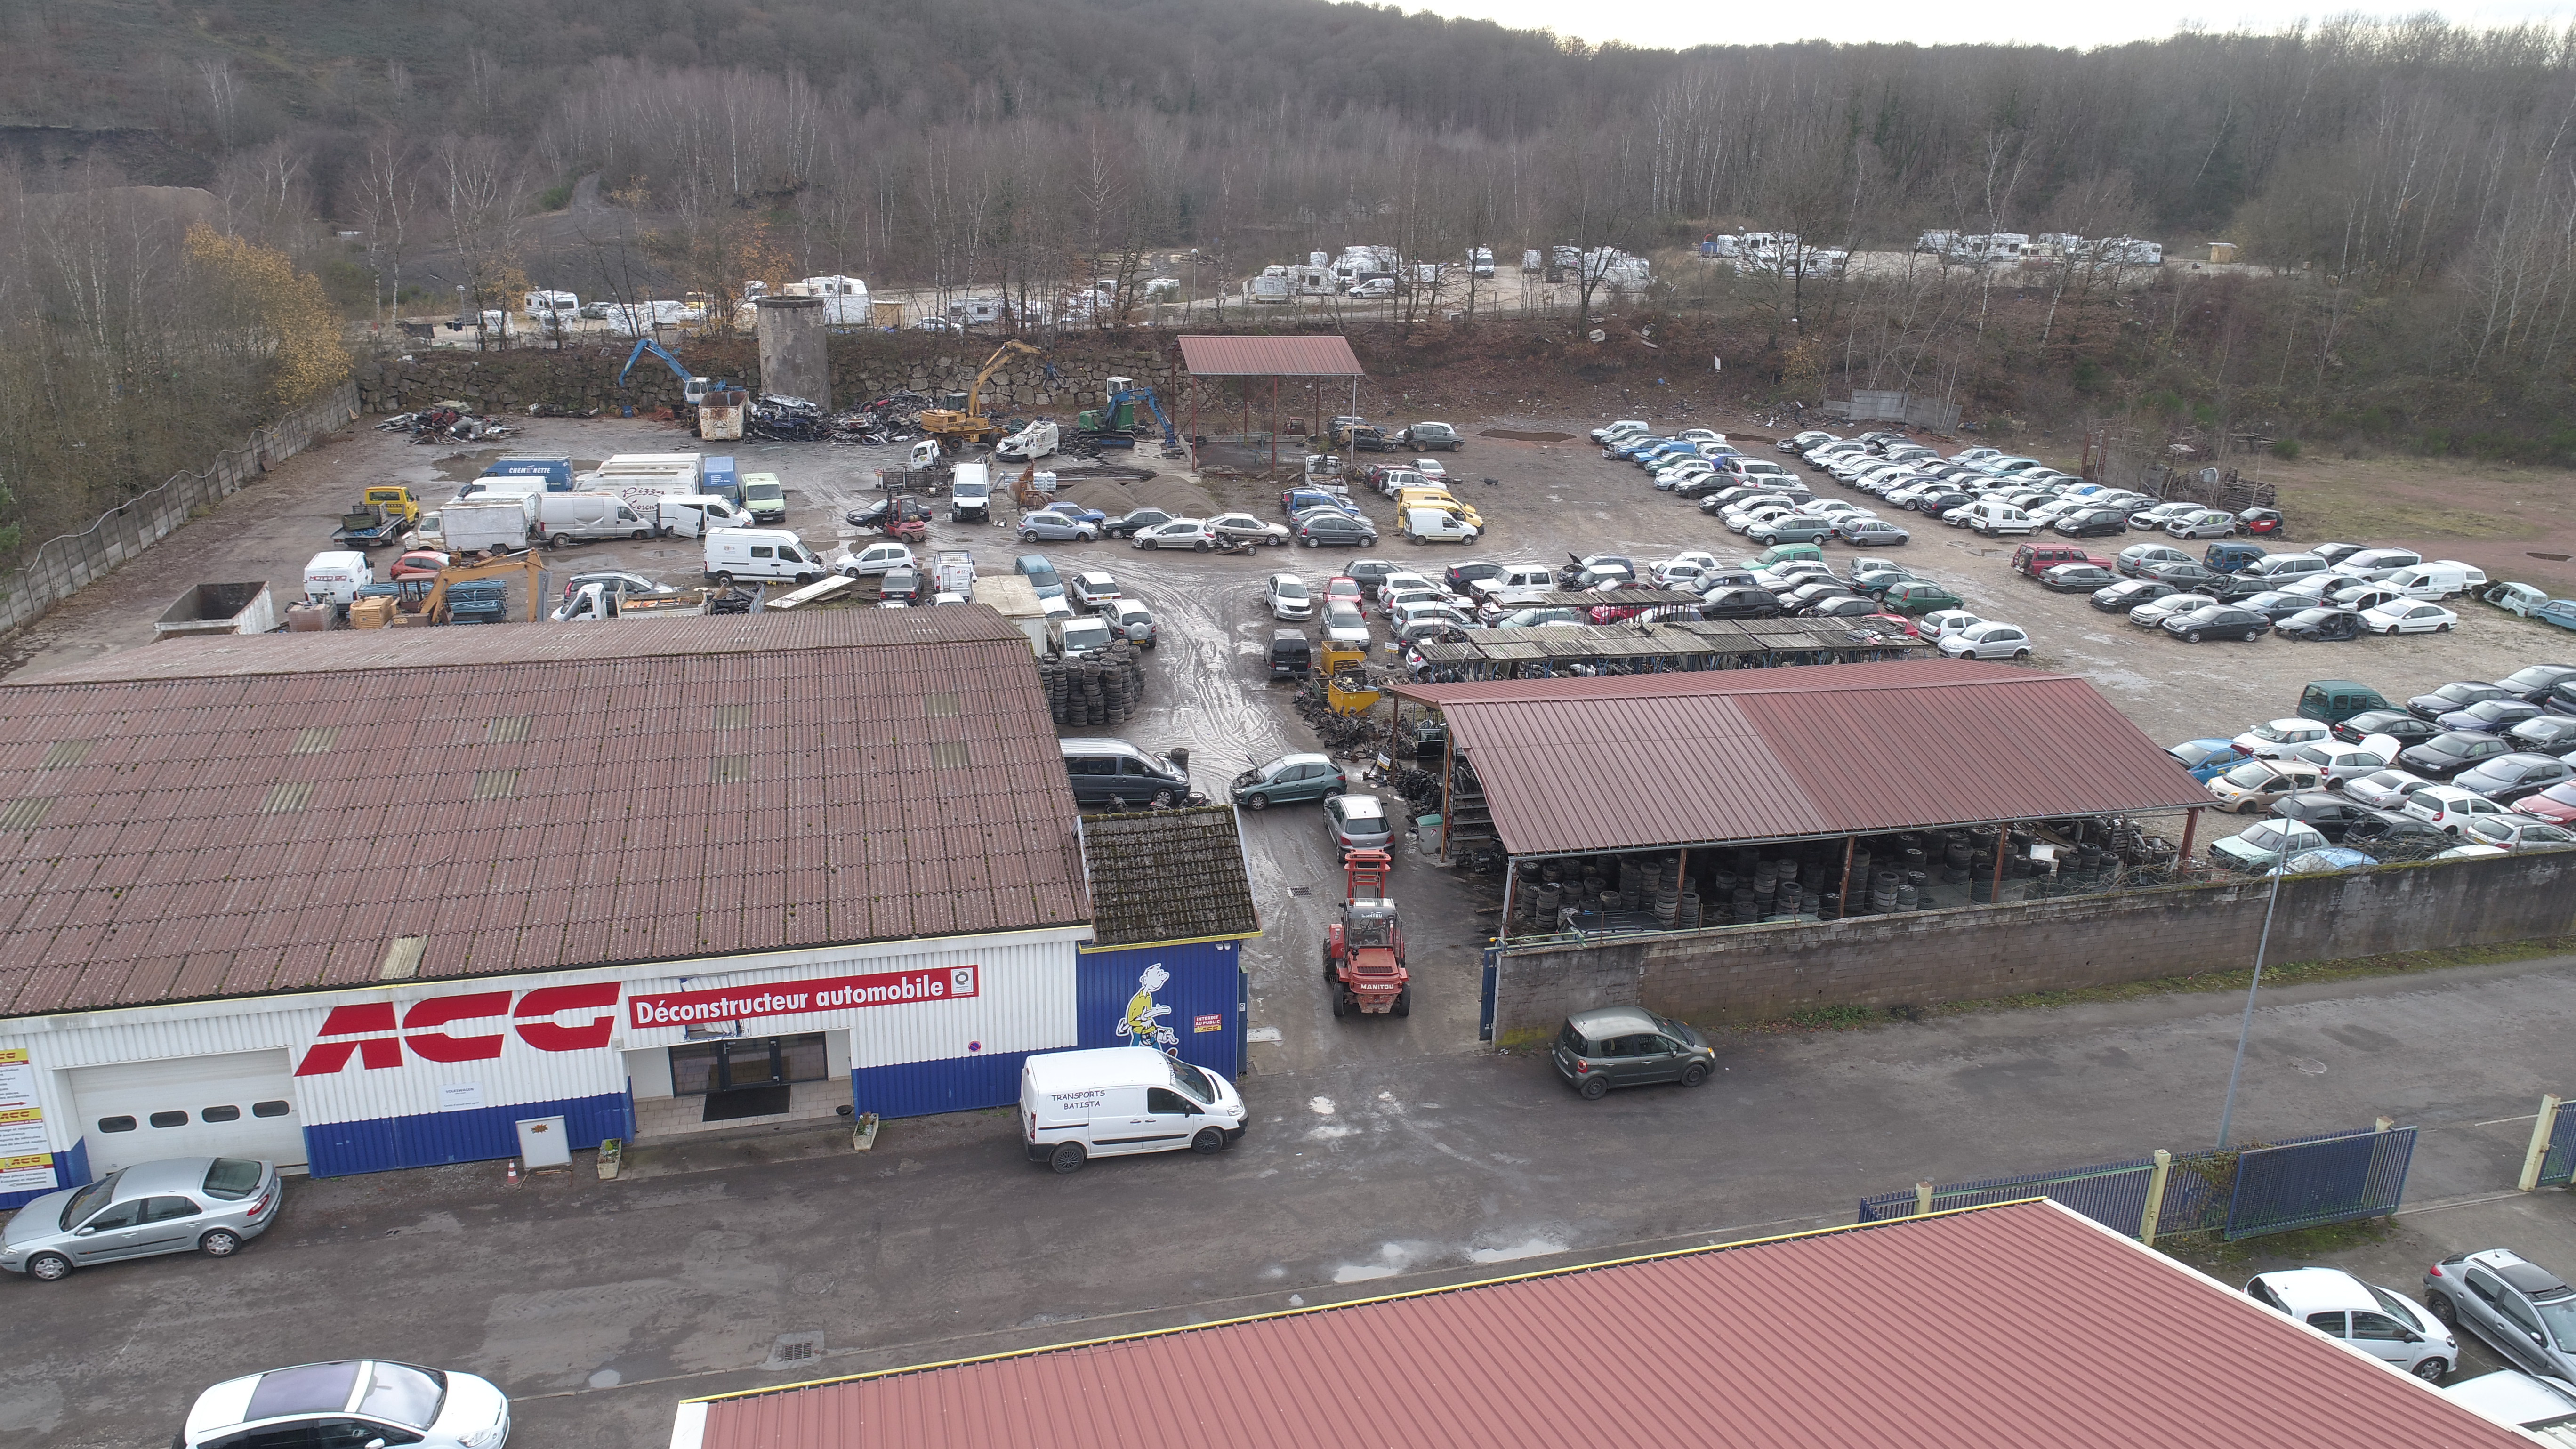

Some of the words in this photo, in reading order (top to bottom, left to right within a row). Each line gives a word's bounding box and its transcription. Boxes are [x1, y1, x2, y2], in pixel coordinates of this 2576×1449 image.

[622, 487, 665, 497] Pizza
[636, 993, 808, 1024] Déconstructeur
[816, 974, 944, 1005] automobile
[1051, 1090, 1105, 1101] TRANSPORTS
[1063, 1101, 1100, 1110] BATISTA
